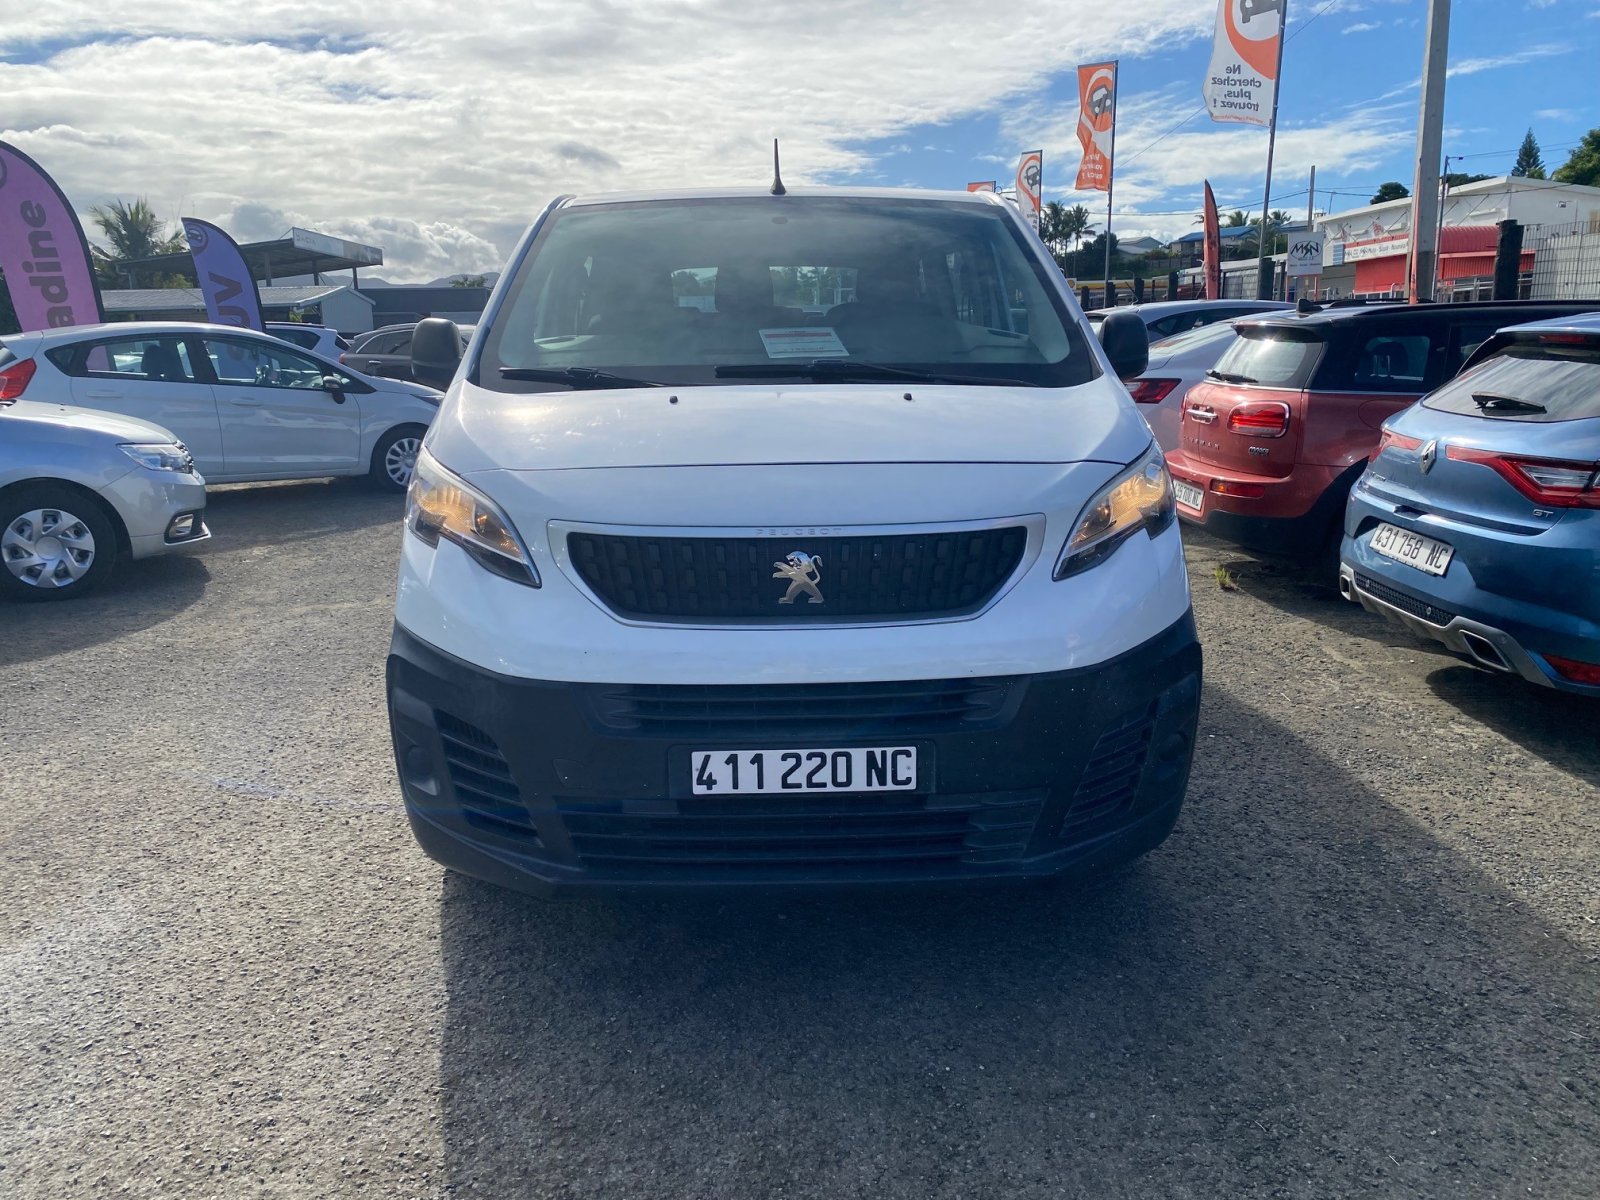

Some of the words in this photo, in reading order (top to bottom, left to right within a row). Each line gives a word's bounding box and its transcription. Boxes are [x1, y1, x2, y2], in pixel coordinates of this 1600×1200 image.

[1290, 241, 1320, 258] MSN
[208, 271, 251, 330] UV
[1533, 508, 1554, 518] GT
[754, 527, 842, 537] PEUGEOT
[1375, 525, 1400, 551] 431
[1398, 534, 1424, 560] 758
[1425, 543, 1449, 569] NC
[696, 752, 764, 791] 411
[780, 750, 853, 790] 220
[865, 749, 913, 788] NC
